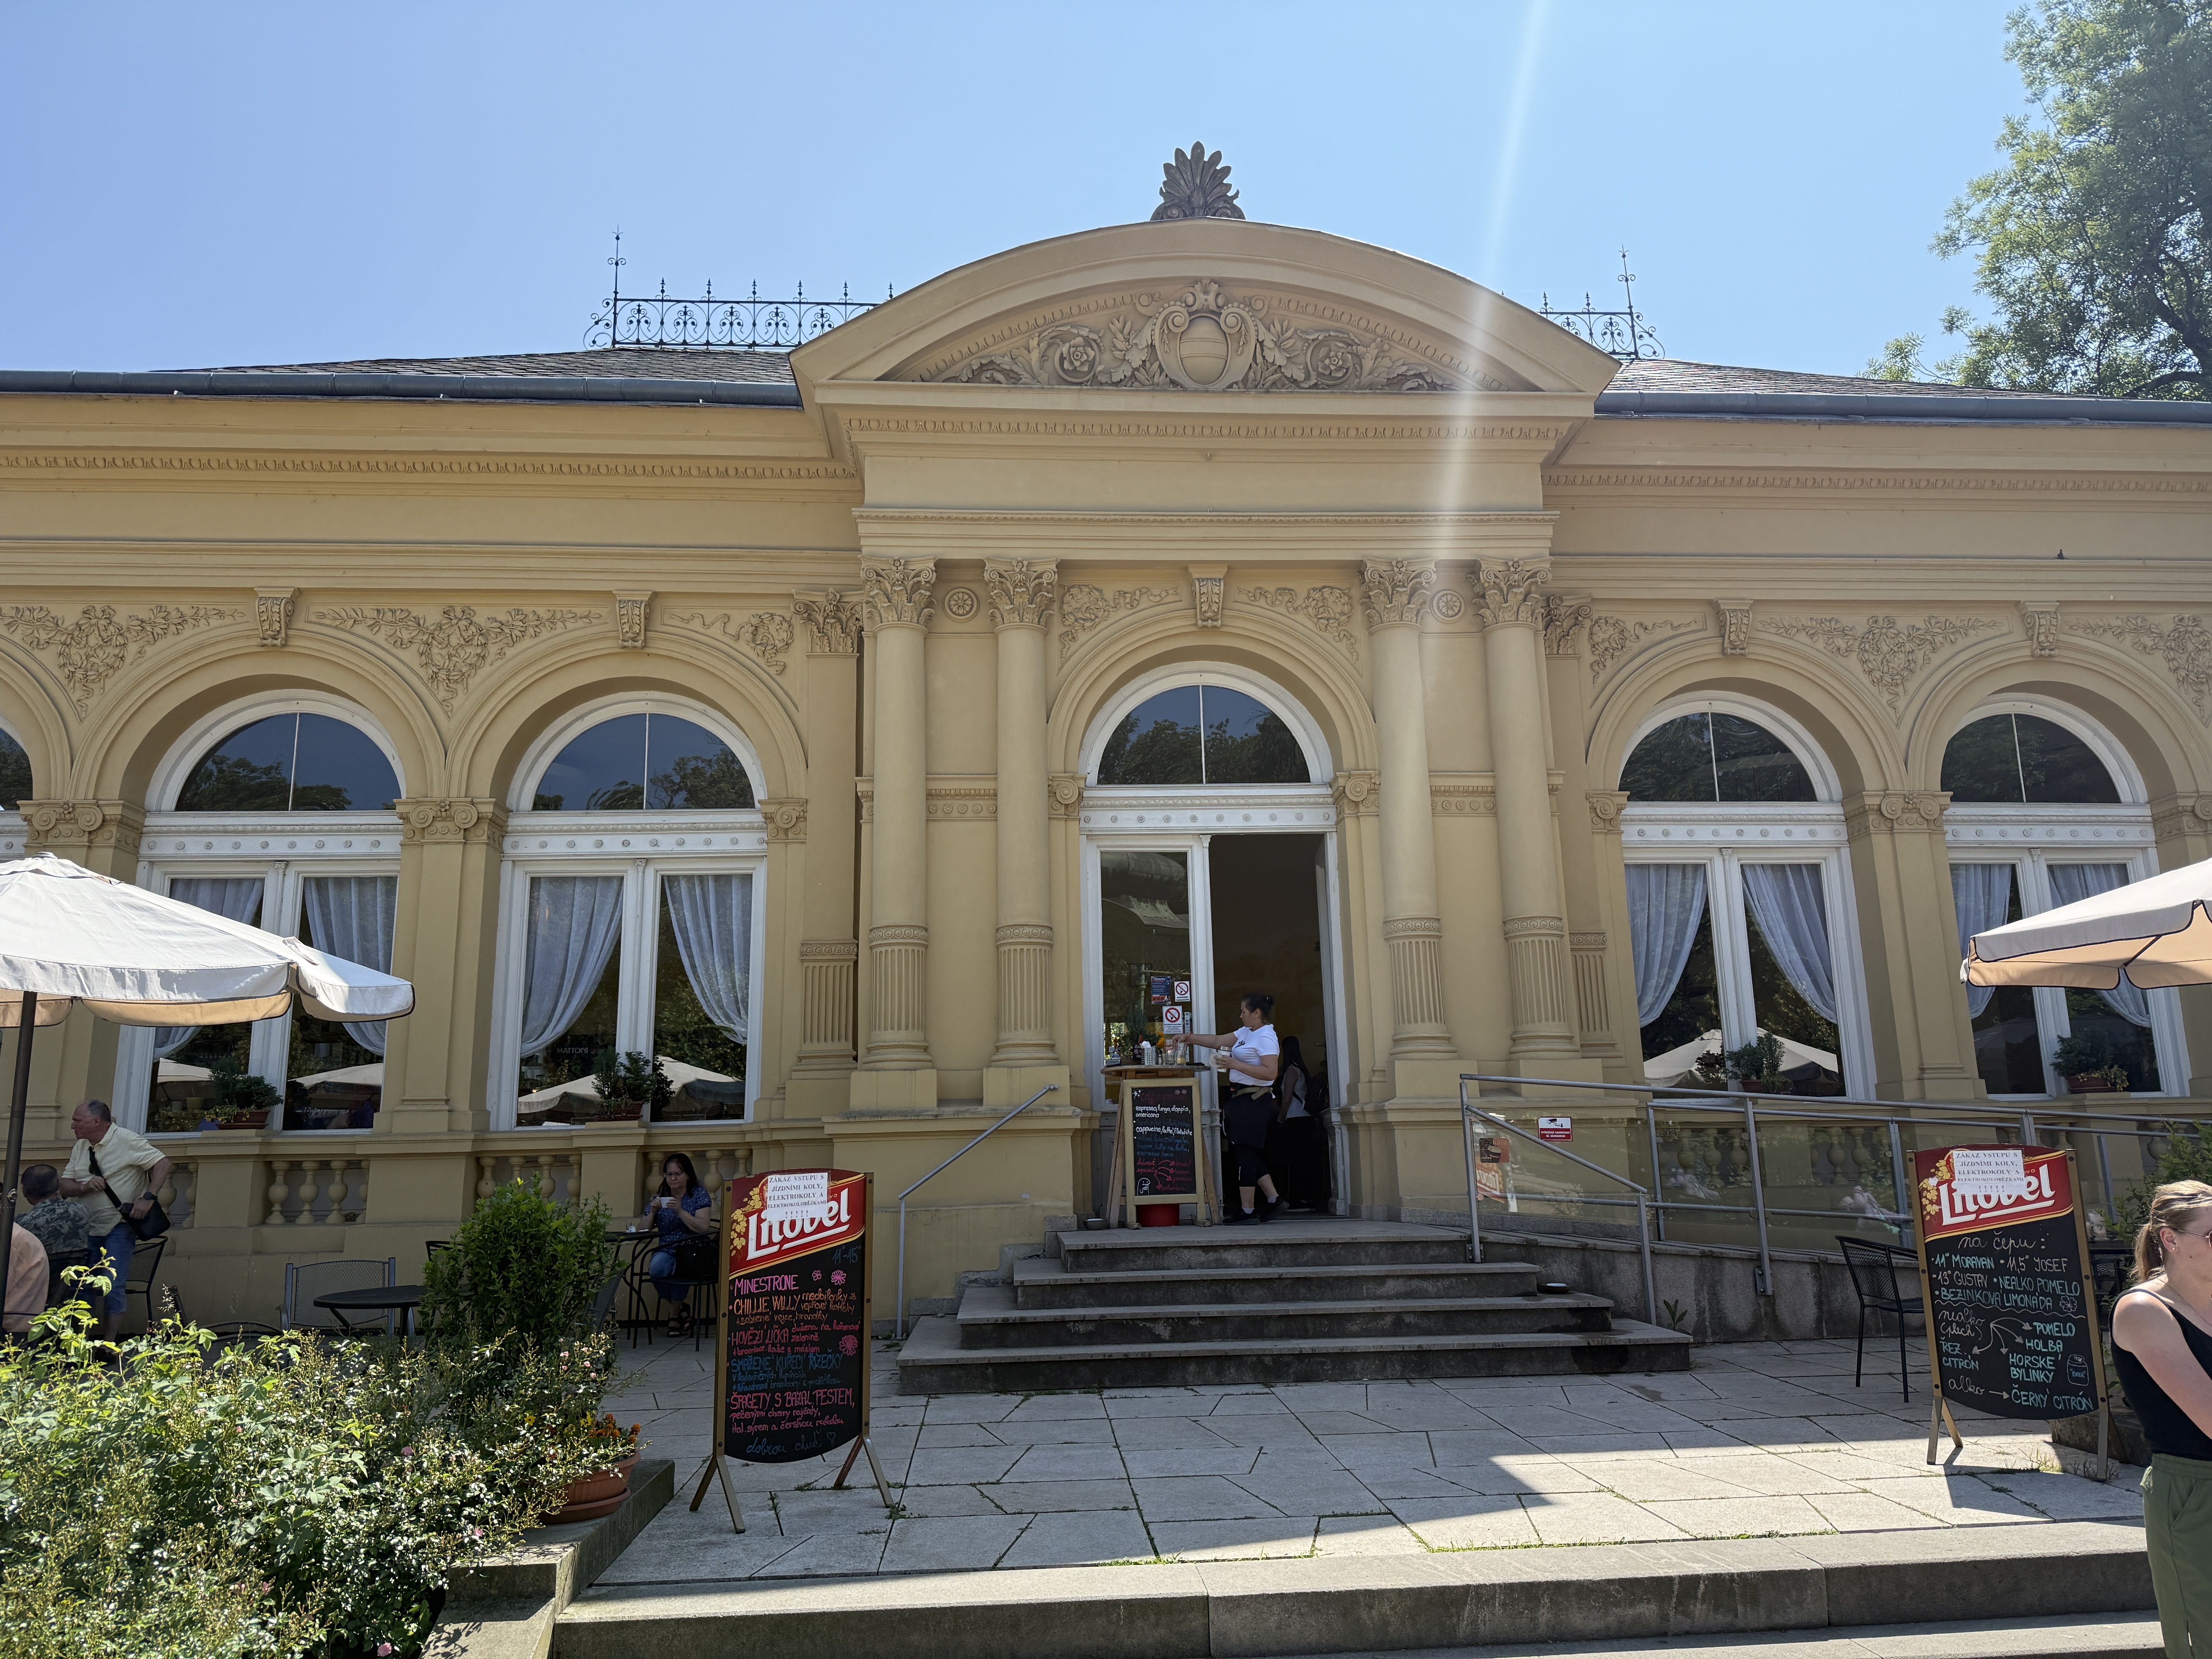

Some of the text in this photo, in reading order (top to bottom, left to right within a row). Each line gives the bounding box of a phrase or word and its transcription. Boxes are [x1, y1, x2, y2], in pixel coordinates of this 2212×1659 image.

[768, 1200, 826, 1208] ELEKTROKOLOBĚŽKAMI
[769, 1192, 816, 1200] ELEKTROKOLY
[1958, 1237, 1988, 1249] na
[1952, 1254, 1995, 1269] MORAVAN
[2033, 1257, 2068, 1273] JOSEF
[734, 1274, 799, 1297] MINESTRONE
[1954, 1271, 1987, 1288] GUSTAV
[1999, 1276, 2033, 1291] NEALKO
[2037, 1278, 2080, 1296] POMELO
[734, 1297, 770, 1316] CHILLIE
[772, 1294, 800, 1311] WILLY
[1941, 1287, 2052, 1310] BEZINKOVÁ LIMONÁDA
[1939, 1308, 1985, 1326] nealko
[2033, 1322, 2075, 1336] POMELO
[2025, 1339, 2063, 1353] HOLBA
[1942, 1355, 1979, 1370] CITRÓN
[2009, 1353, 2061, 1369] HORSKÉ
[2010, 1367, 2054, 1383] BYLINKY
[1949, 1376, 1985, 1395] alko
[730, 1391, 771, 1410] ŠPAGETY
[775, 1392, 782, 1407] S
[812, 1388, 855, 1408] PESTEM,
[2011, 1383, 2094, 1411] ČERNÝ CITRÓN
[768, 1407, 790, 1420] cherry
[747, 1437, 787, 1455] dobrou
